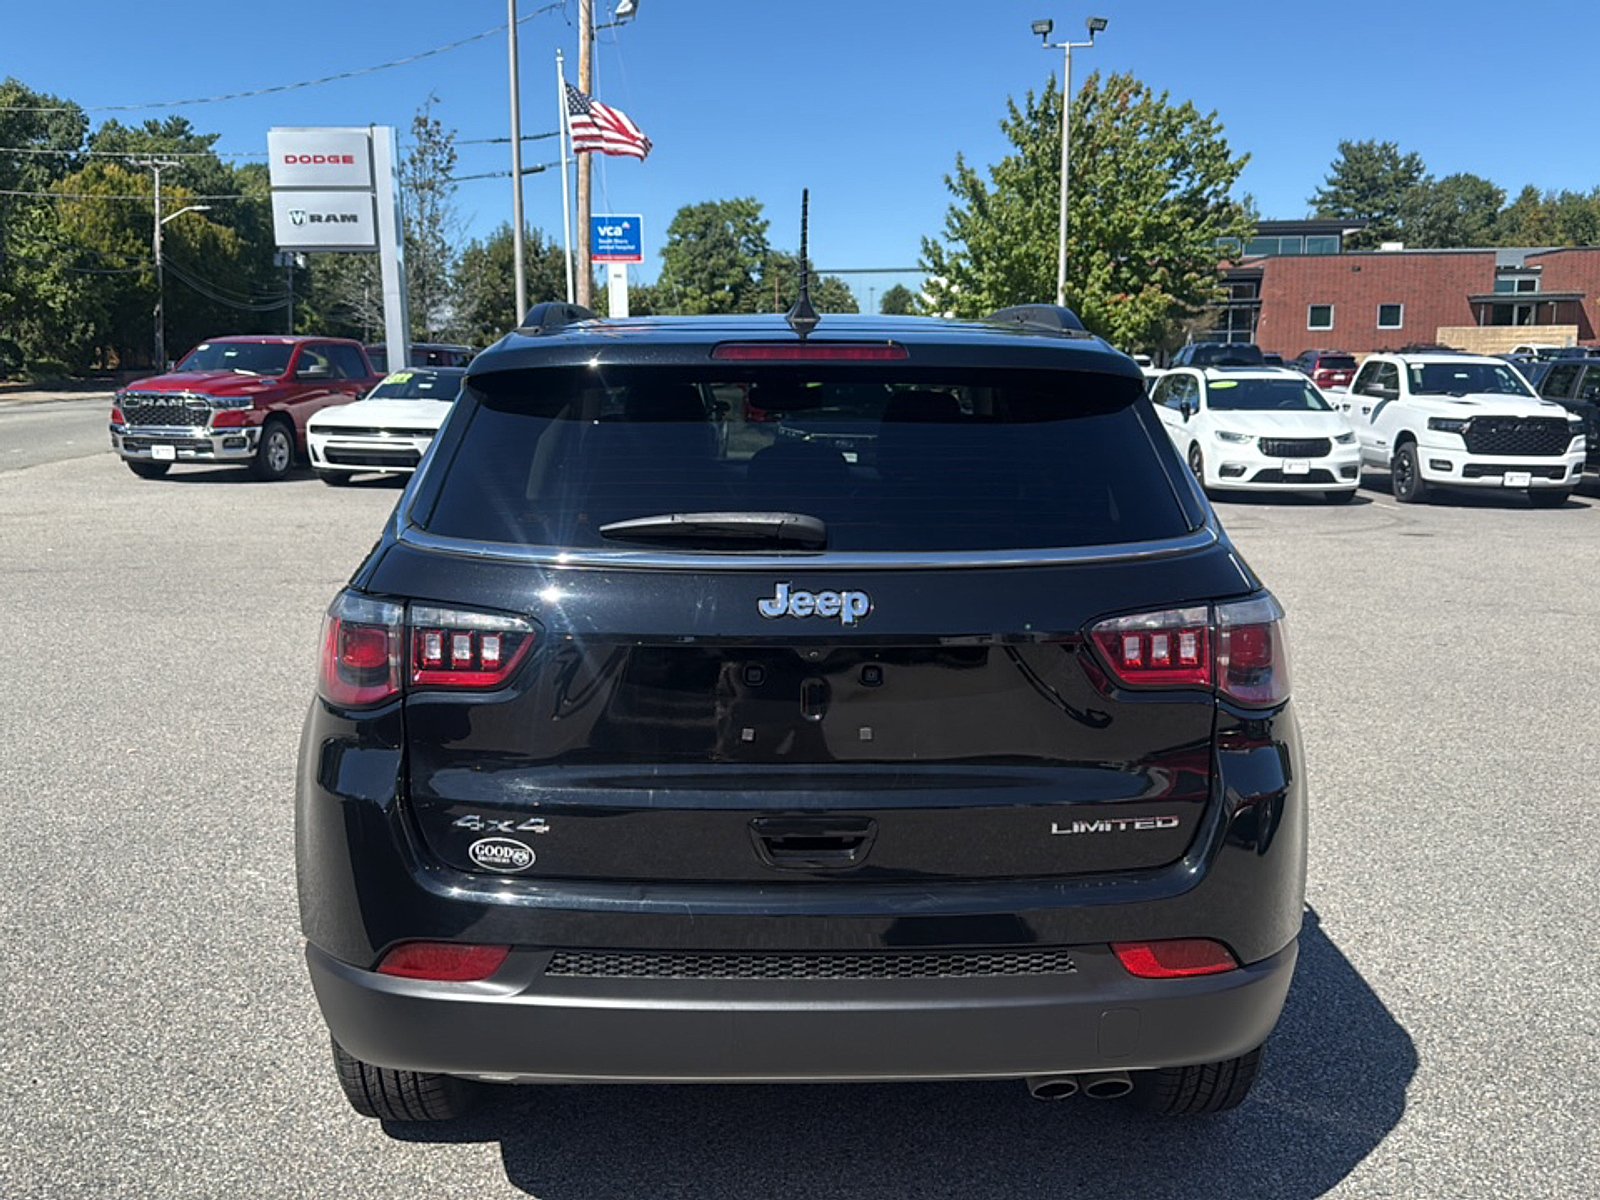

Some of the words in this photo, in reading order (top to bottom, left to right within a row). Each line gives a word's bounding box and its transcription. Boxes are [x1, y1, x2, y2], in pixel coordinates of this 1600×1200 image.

[284, 154, 354, 165] DODGE
[308, 213, 358, 223] RAM
[597, 225, 623, 237] vca
[757, 581, 872, 627] Jeep
[1050, 815, 1180, 835] LIMITED
[475, 844, 514, 858] GOOD
